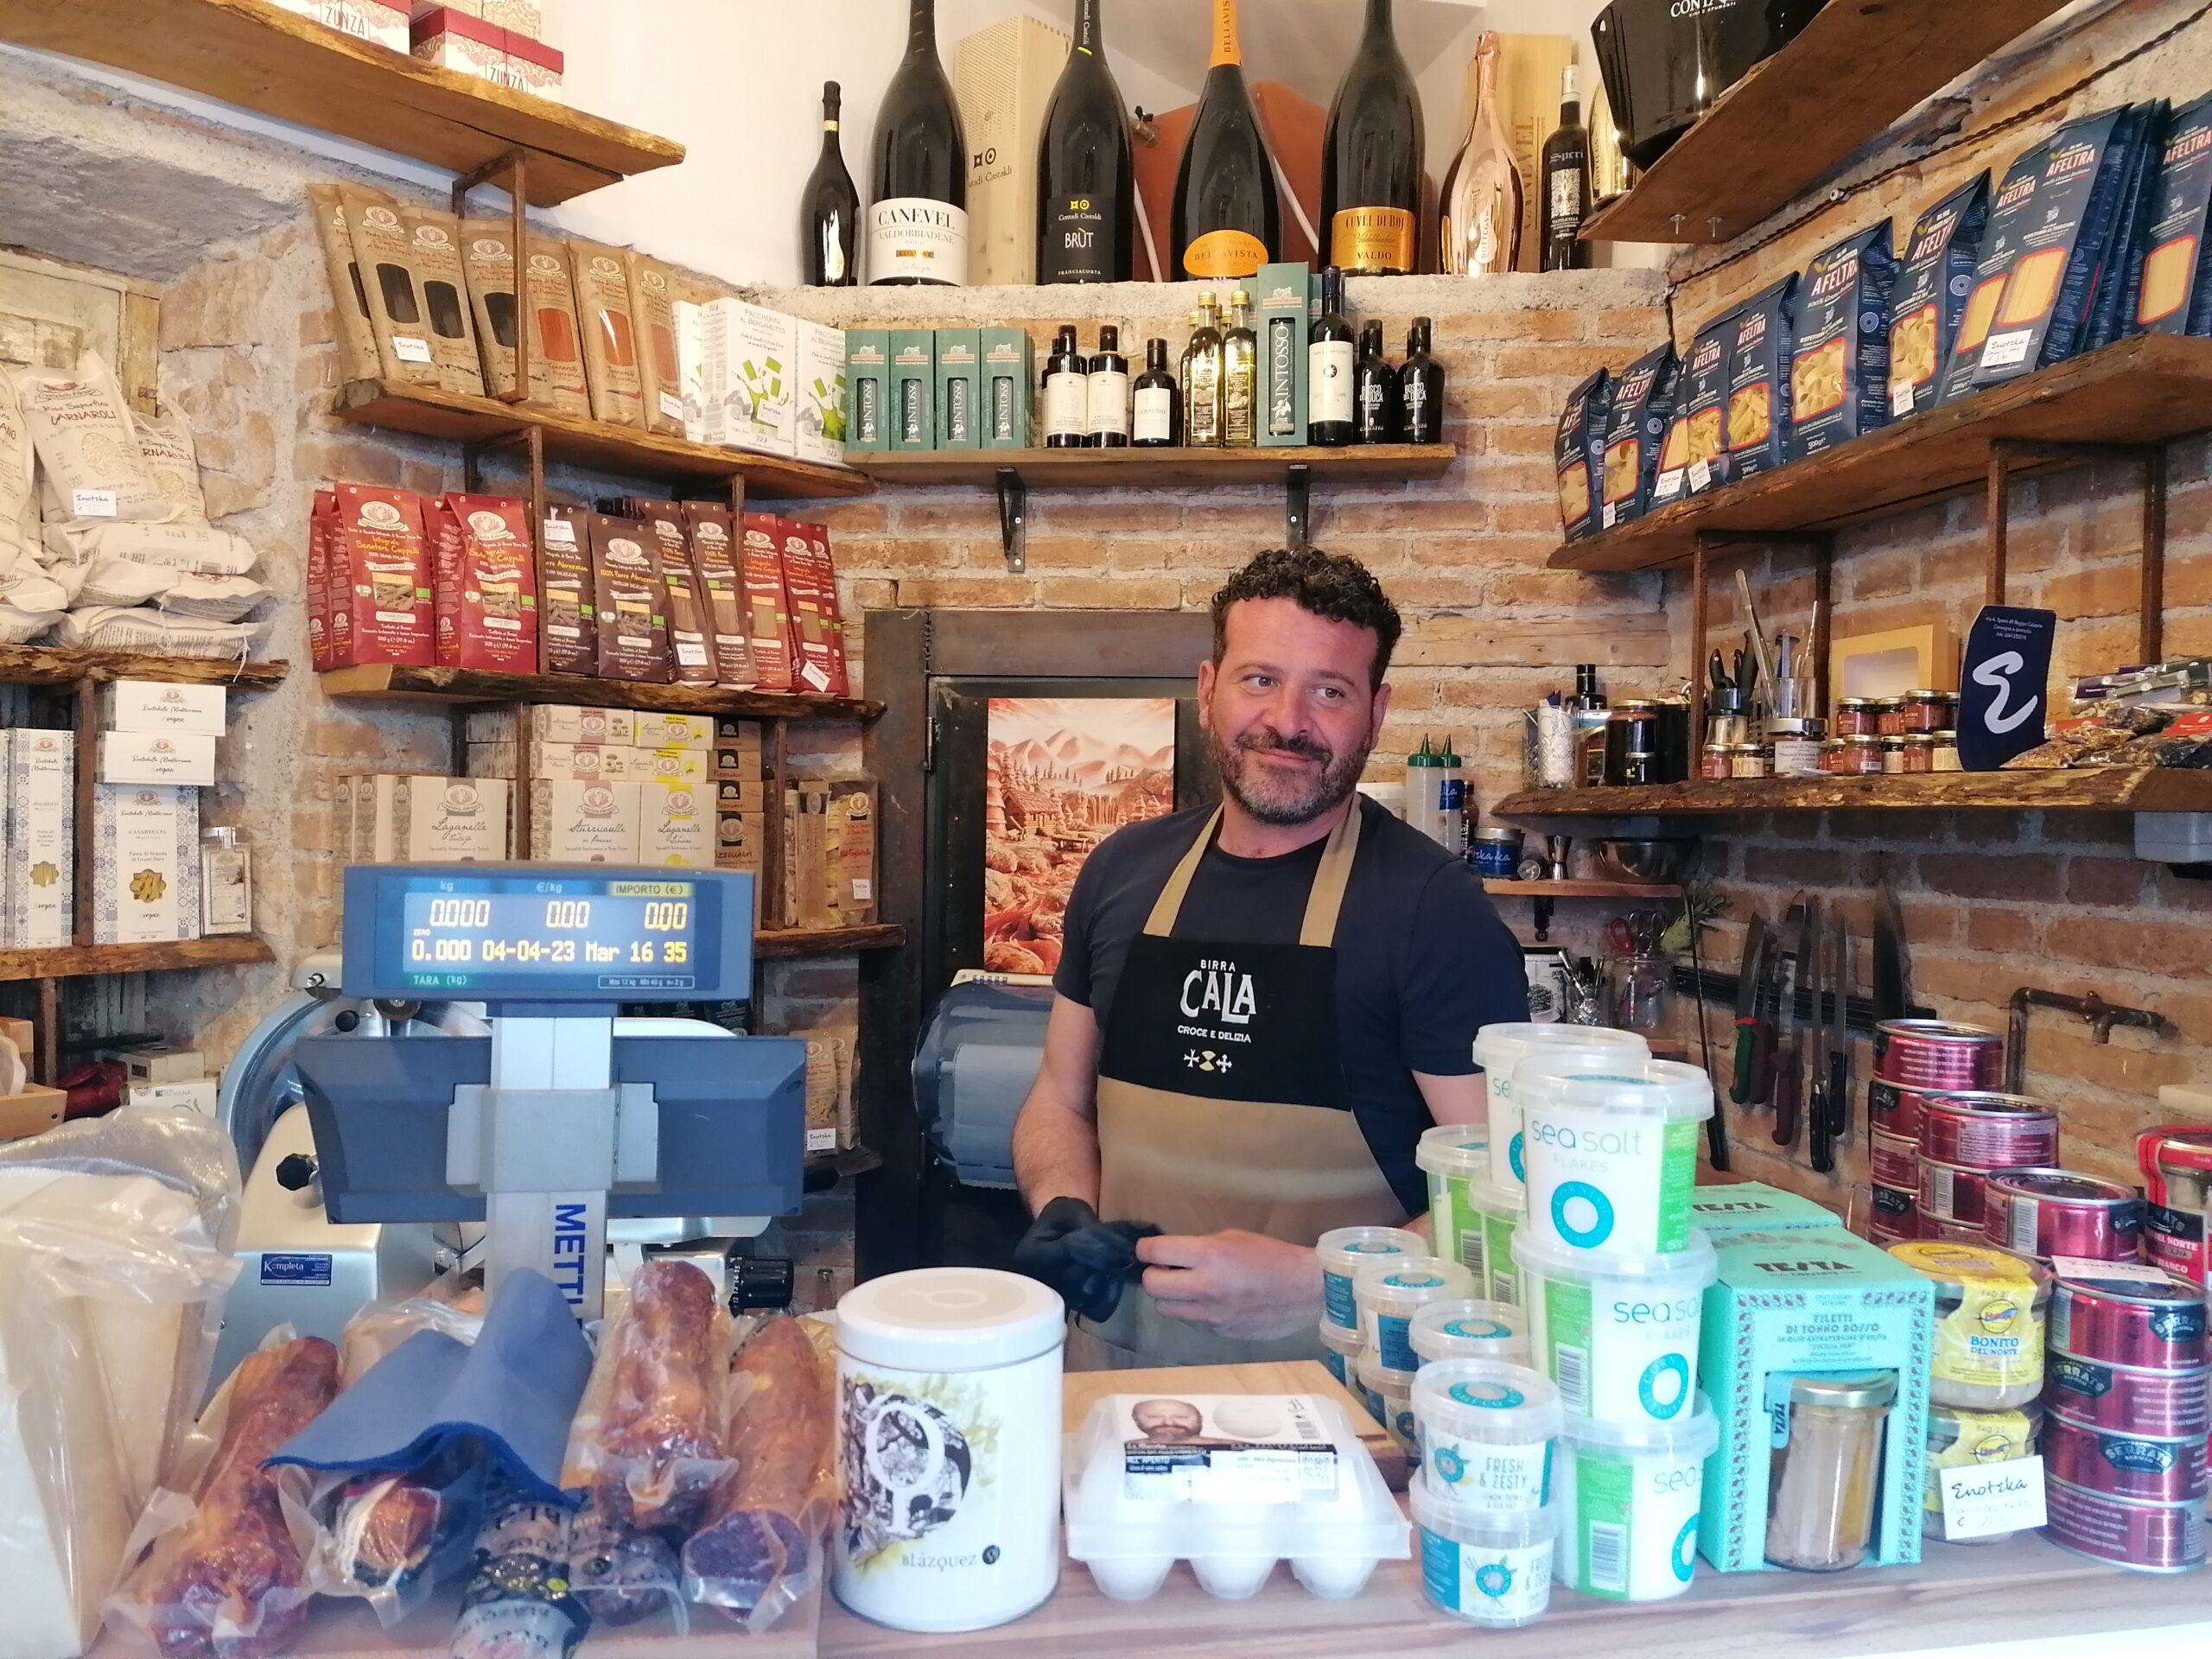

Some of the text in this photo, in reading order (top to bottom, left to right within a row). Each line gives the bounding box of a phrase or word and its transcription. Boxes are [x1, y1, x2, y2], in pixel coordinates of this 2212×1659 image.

[324, 5, 365, 36] ZUNZA
[1548, 149, 1584, 164] Speri
[2163, 130, 2212, 165] AFELTRA
[2046, 149, 2095, 177] AFELTRA
[985, 165, 1013, 182] Castaldi
[1996, 179, 2037, 208] AFELTRA
[878, 207, 956, 230] CANEVEL
[879, 228, 954, 245] VALDOBBIADENE
[1811, 258, 1858, 296] AFELTRA
[745, 308, 781, 325] PACCHERINI
[1737, 318, 1767, 346] AFELTRA
[1274, 325, 1289, 397] INTOSSO
[1692, 346, 1721, 372] AFELTRA
[1404, 382, 1425, 393] BOSCO
[864, 378, 873, 422] INTOSSO
[908, 379, 917, 423] INTOSSO
[953, 379, 963, 423] INTOSSO
[1000, 378, 1008, 420] INTOSSO
[50, 410, 118, 425] CARNAROLI
[391, 544, 420, 556] Cappelli
[715, 850, 753, 859] izzoccheri
[441, 880, 454, 893] kg
[536, 881, 563, 893] €/kg
[616, 884, 661, 894] IMPORTO
[411, 939, 472, 962] 0.000
[482, 939, 575, 962] 04-04-23
[585, 941, 620, 962] Mar
[1200, 959, 1236, 972] BIRRA
[413, 975, 467, 987] TARA (kg)
[1179, 969, 1257, 1024] CALA
[1177, 1025, 1207, 1037] CROCE
[1218, 1031, 1251, 1043] DELIZIA
[1493, 1077, 1510, 1097] se
[1532, 1120, 1642, 1155] sea salt
[1553, 1155, 1609, 1173] FLAKES
[2167, 1236, 2199, 1251] NORTE
[264, 1261, 304, 1272] Kompleta
[554, 1204, 586, 1330] METT
[1753, 1261, 1855, 1274] TESTA
[1614, 1301, 1671, 1323] sea
[1815, 1313, 1853, 1324] FILETTI
[1786, 1325, 1797, 1333] DI
[1803, 1324, 1840, 1333] TONNO
[1970, 1335, 2018, 1348] BONITO
[1971, 1346, 1986, 1355] DEL
[1485, 1456, 1524, 1472] FRESH
[2105, 1444, 2173, 1467] SERRATS
[1492, 1474, 1527, 1491] ZESTY
